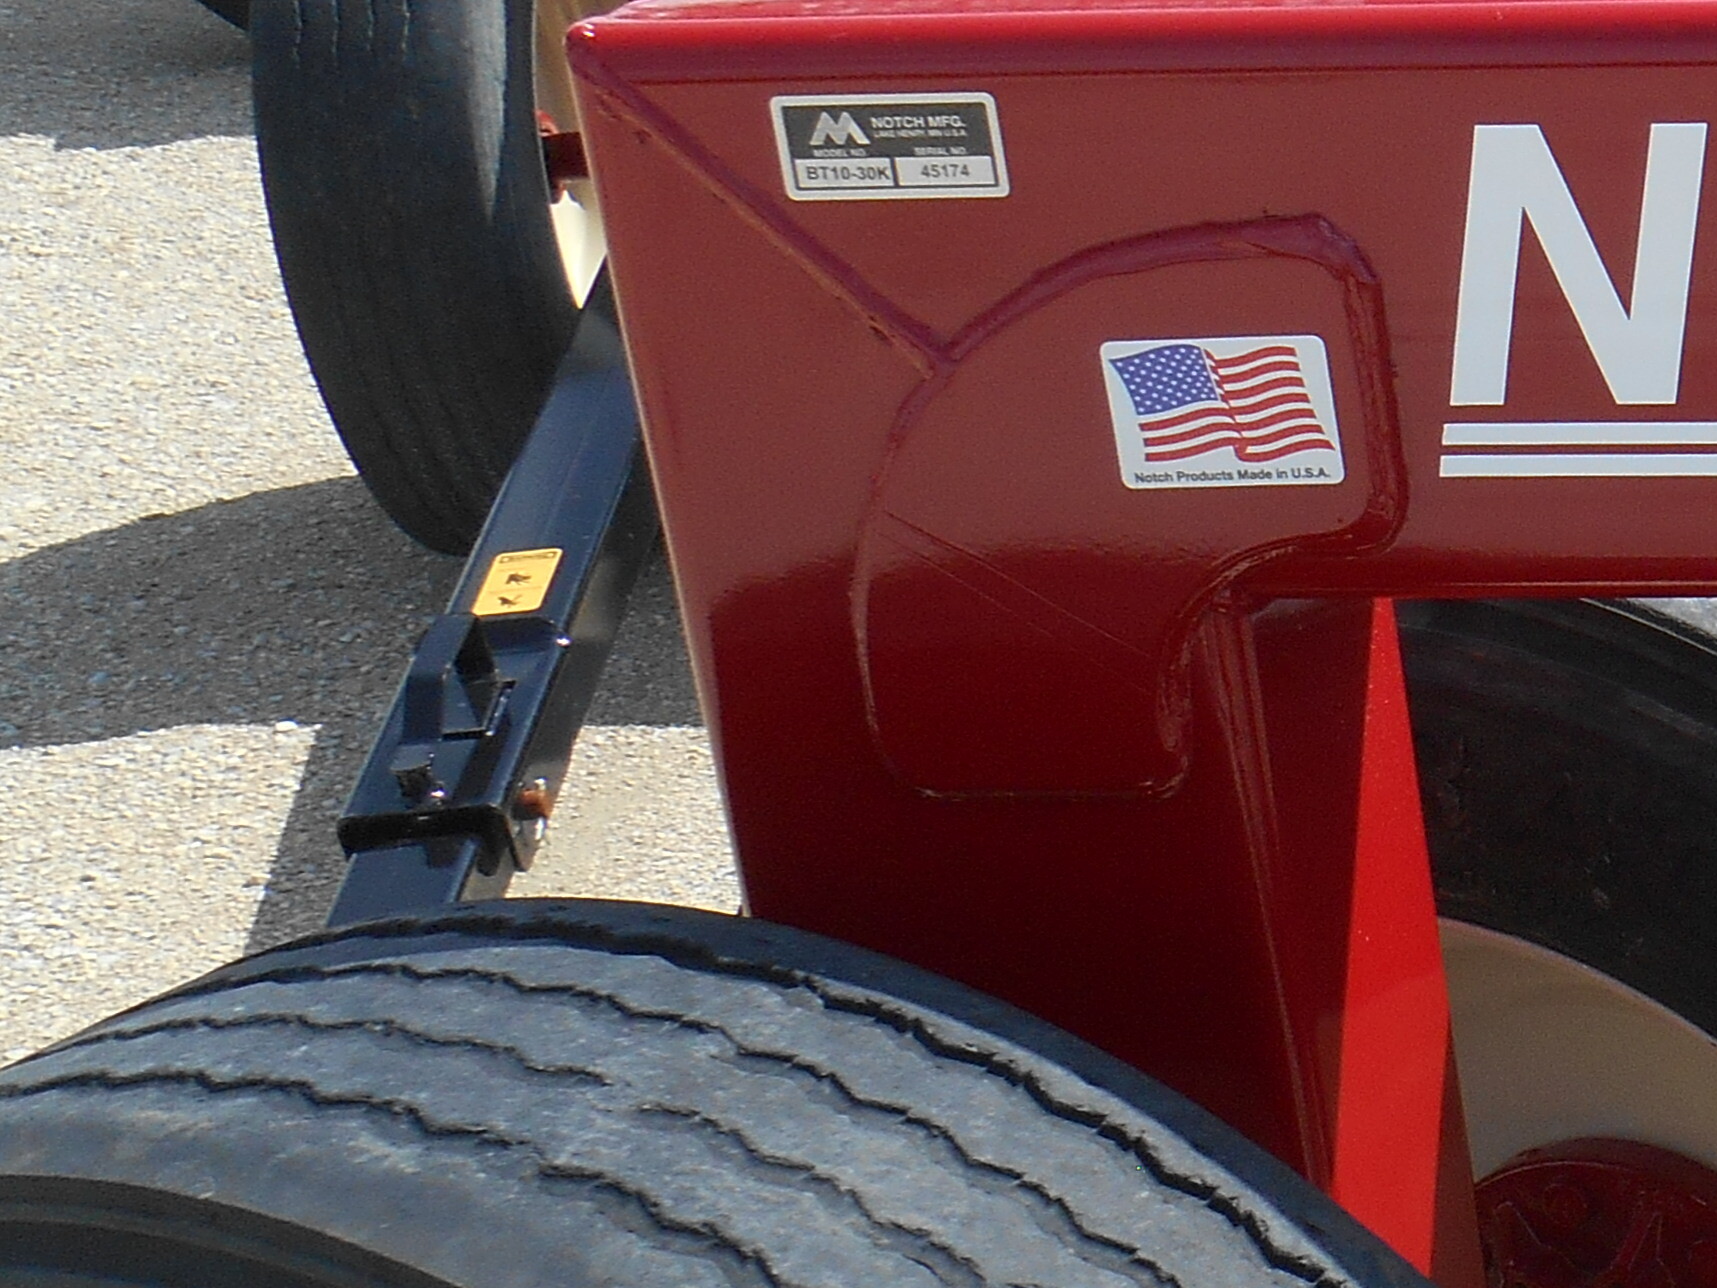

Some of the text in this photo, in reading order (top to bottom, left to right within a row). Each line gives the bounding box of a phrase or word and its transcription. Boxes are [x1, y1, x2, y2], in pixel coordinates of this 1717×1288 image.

[870, 115, 967, 128] NOTCH MFG.
[806, 165, 890, 180] BT10-30K
[920, 164, 970, 178] 45174
[1134, 466, 1331, 484] Notch Products Made in U.S.A.
